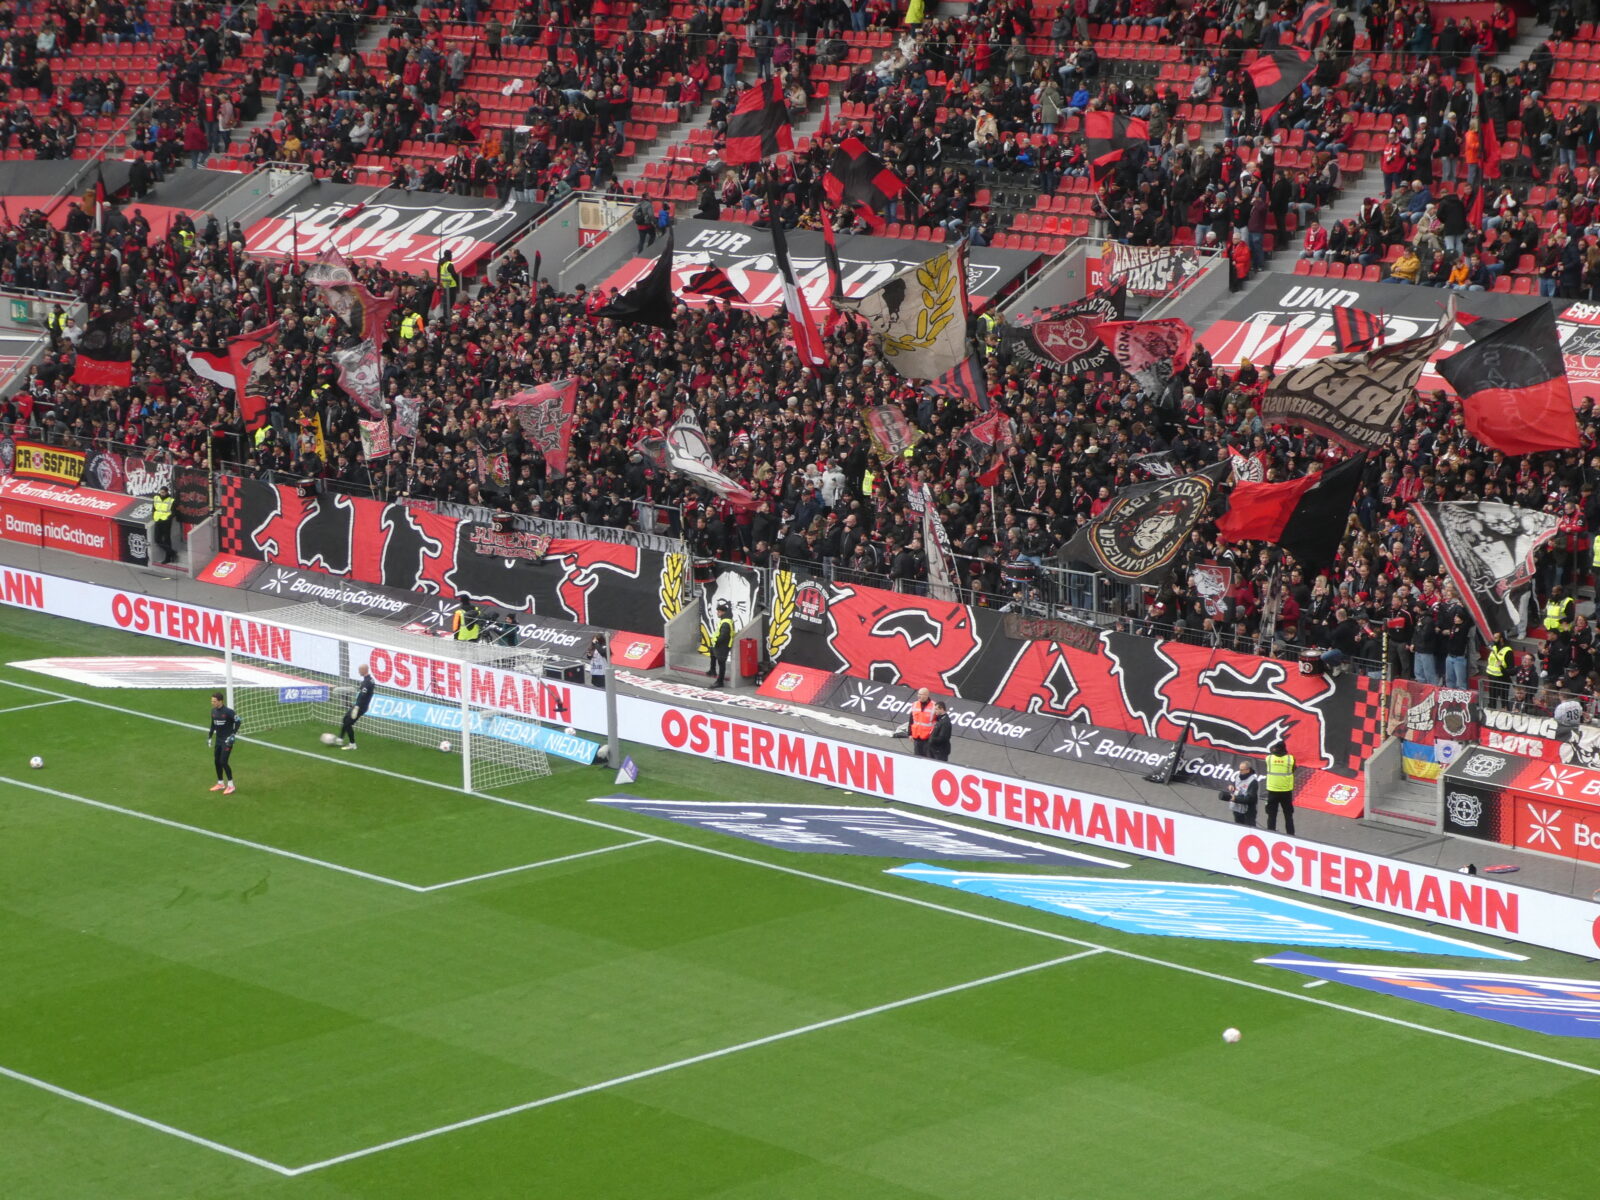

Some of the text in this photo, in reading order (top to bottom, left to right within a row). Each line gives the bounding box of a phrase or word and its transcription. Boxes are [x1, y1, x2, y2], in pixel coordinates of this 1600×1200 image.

[686, 229, 752, 253] FÜR
[1278, 285, 1359, 309] UND
[112, 593, 292, 662] OSTERMANN
[368, 694, 416, 720] IEDAX
[369, 647, 572, 724] OSTERMANN
[488, 716, 539, 747] NIEDAX
[546, 730, 597, 761] NIEDAX
[660, 708, 895, 796] OSTERMANN
[931, 768, 1176, 857] OSTERMANN
[1237, 834, 1519, 935] OSTERMANN
